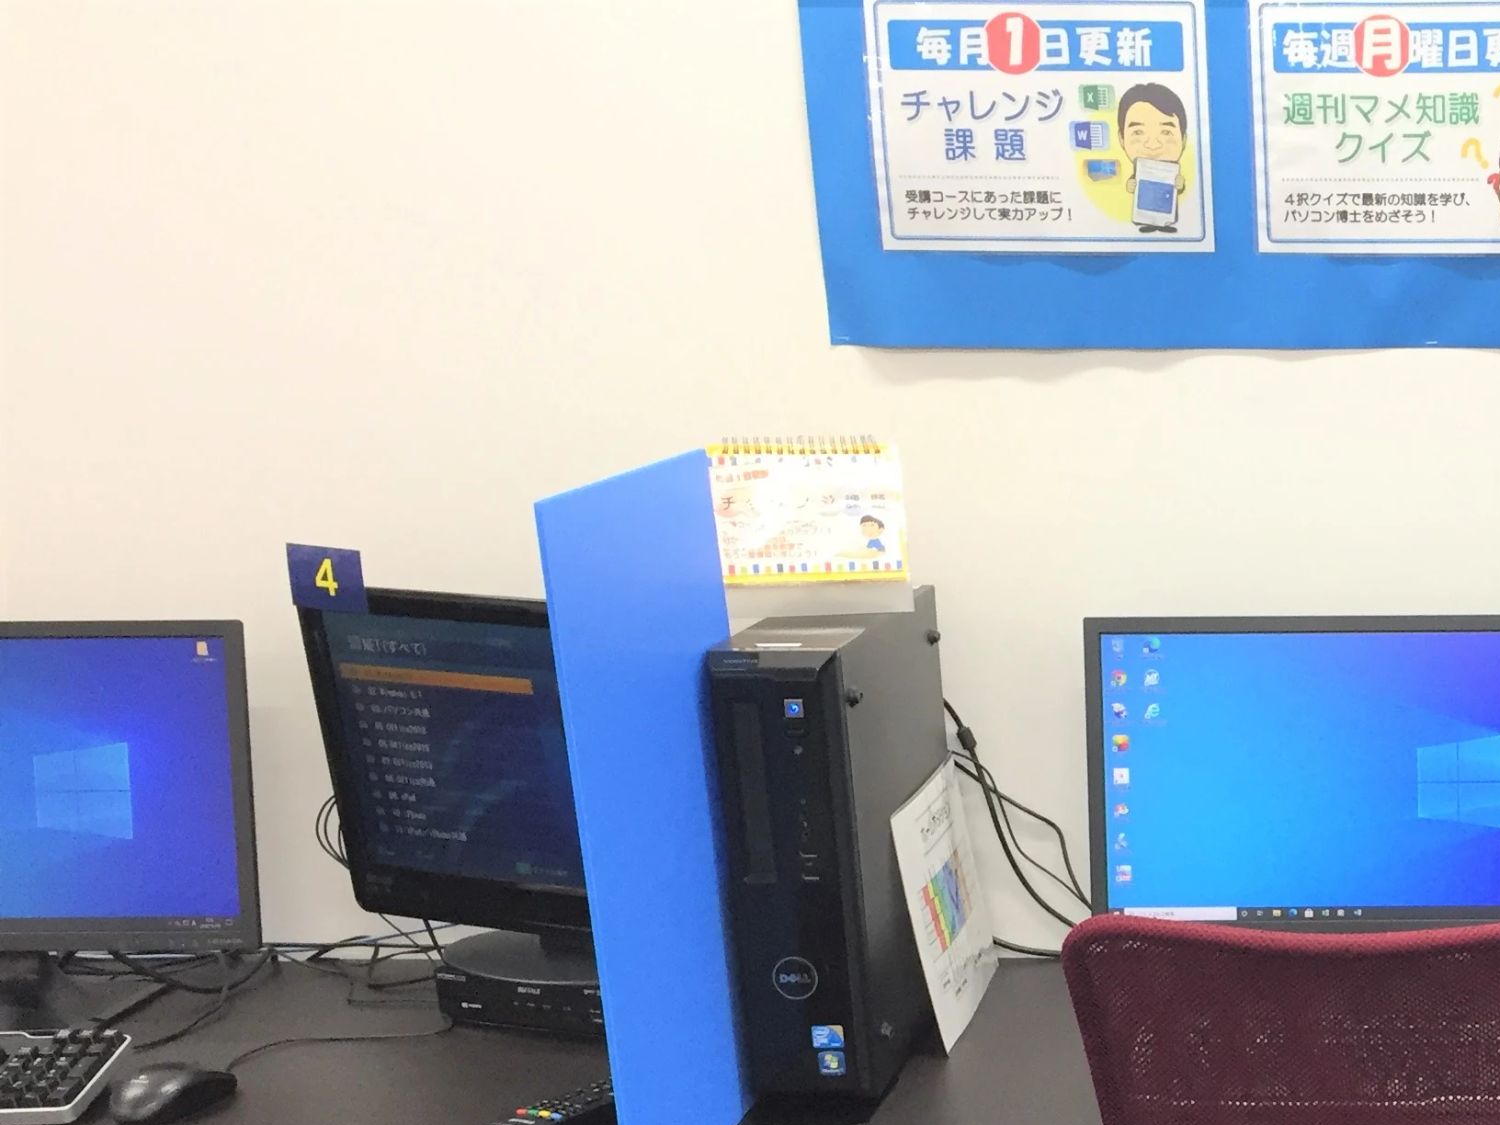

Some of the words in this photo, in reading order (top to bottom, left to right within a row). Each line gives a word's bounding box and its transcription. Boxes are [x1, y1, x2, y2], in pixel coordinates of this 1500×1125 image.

[917, 16, 1152, 66] 毎月1日更新
[901, 89, 1063, 121] チャレンジ
[1283, 92, 1480, 126] 週刊マメ知識
[944, 128, 1026, 161] 課題
[1335, 130, 1432, 164] クイズ
[905, 190, 1062, 204] 受講コースにあった課題に
[907, 207, 1072, 221] チャレンジして実力アップ！
[1284, 210, 1436, 223] パソコン博士をめざそう！
[315, 558, 338, 596] 4
